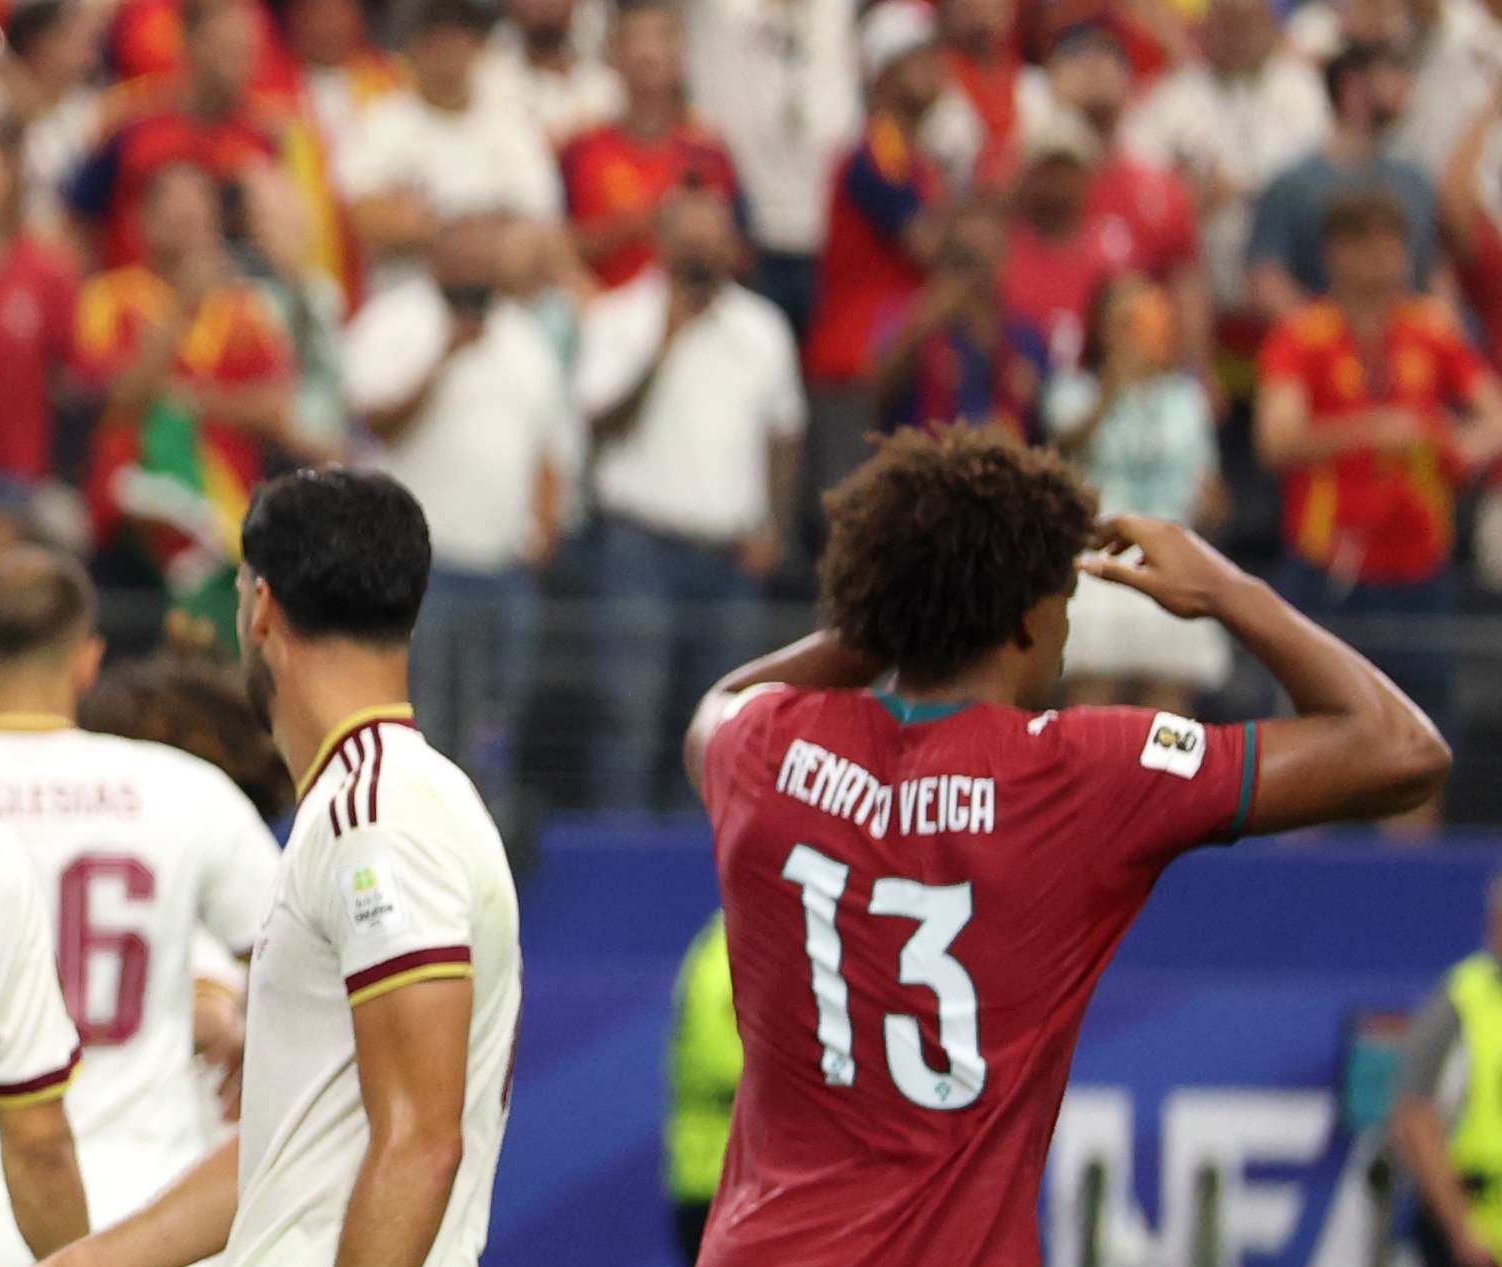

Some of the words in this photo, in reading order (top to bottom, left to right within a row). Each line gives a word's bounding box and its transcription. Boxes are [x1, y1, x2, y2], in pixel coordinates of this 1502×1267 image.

[776, 738, 893, 840] RENATO
[900, 774, 995, 836] VEIGA
[781, 844, 988, 1112] 13
